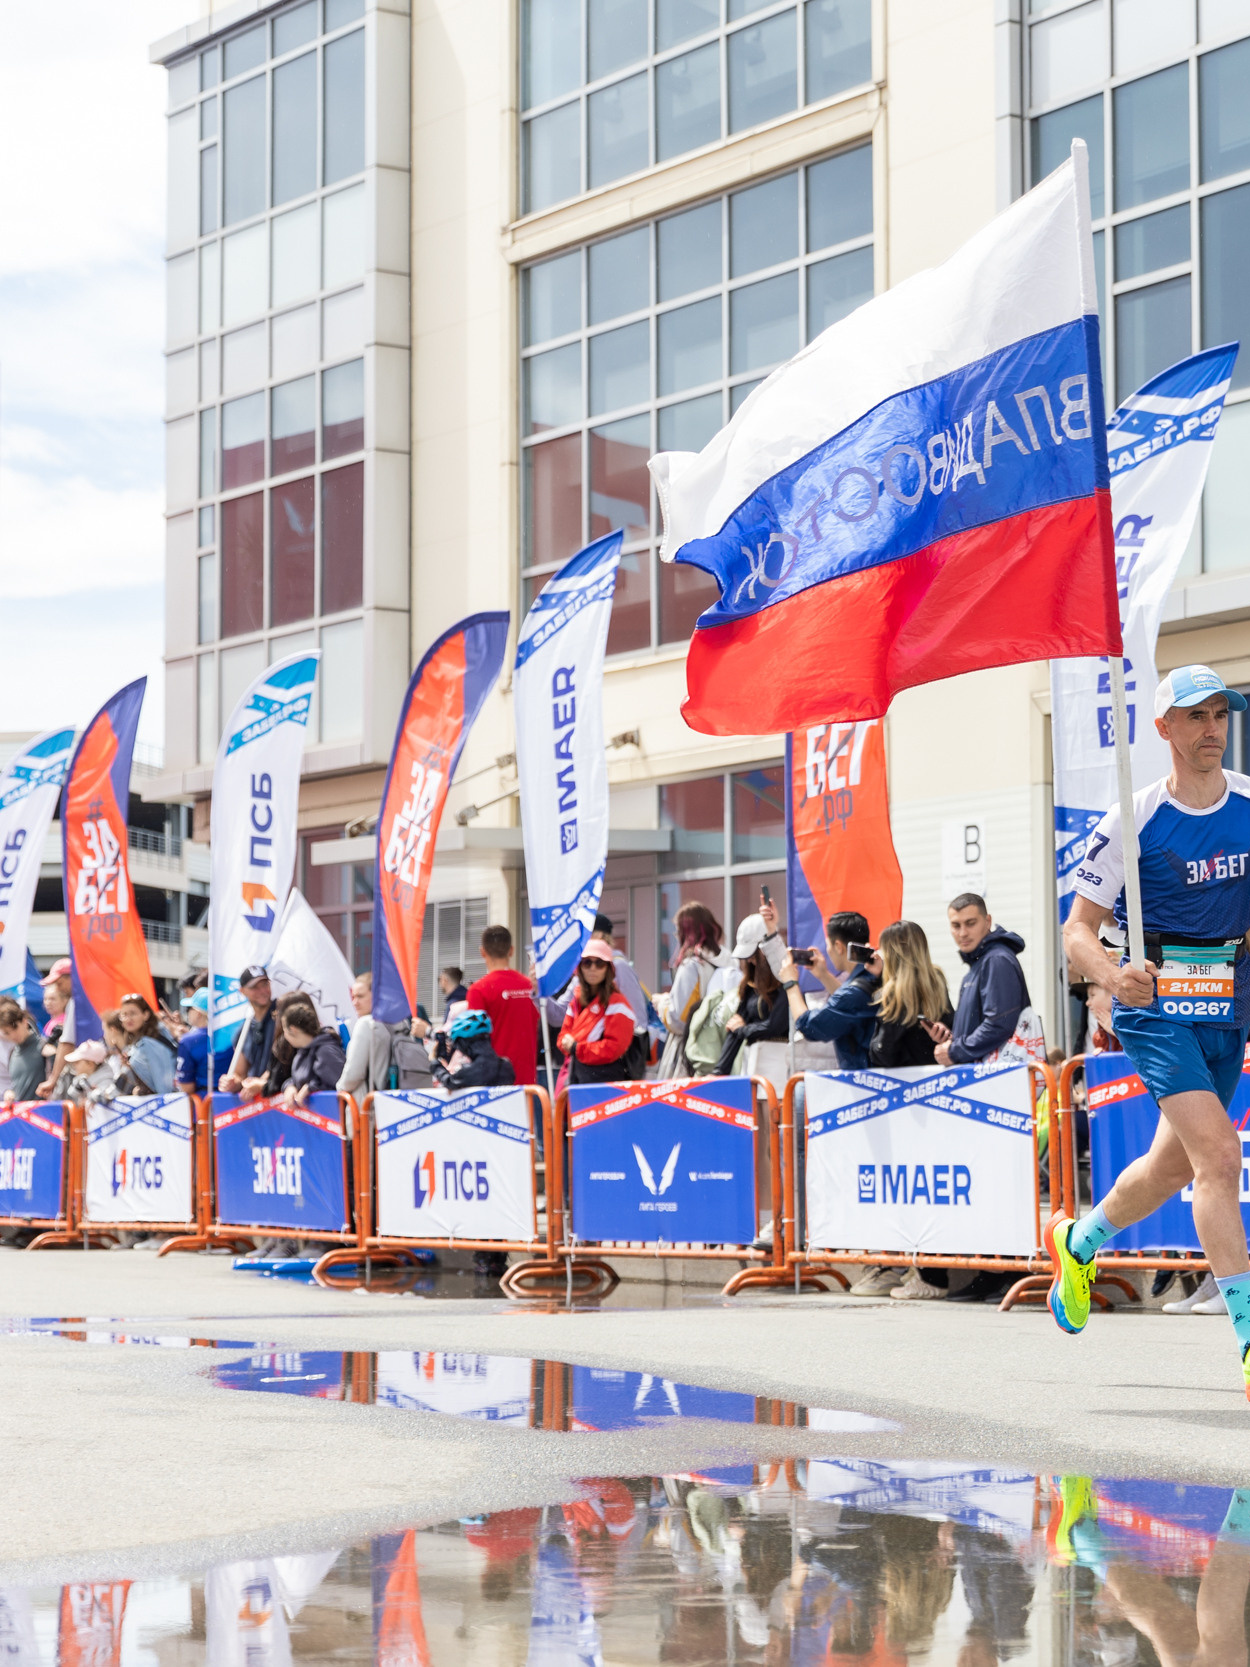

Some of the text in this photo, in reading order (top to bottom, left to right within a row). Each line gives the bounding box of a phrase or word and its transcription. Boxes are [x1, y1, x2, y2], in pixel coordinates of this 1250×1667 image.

[552, 664, 577, 814] MAER
[805, 719, 879, 798] БЕГ
[249, 772, 273, 867] ПСБ
[1187, 853, 1249, 885] ЗАБЕГ
[535, 889, 590, 955] АБЕГ.РФ
[1163, 1001, 1231, 1015] 00267
[836, 1073, 958, 1126] ЗАБЕГ.РФ ЗАБЕГ.РФ
[132, 1156, 163, 1188] ПСБ
[443, 1161, 489, 1201] ПСБ
[882, 1164, 971, 1206] MAER
